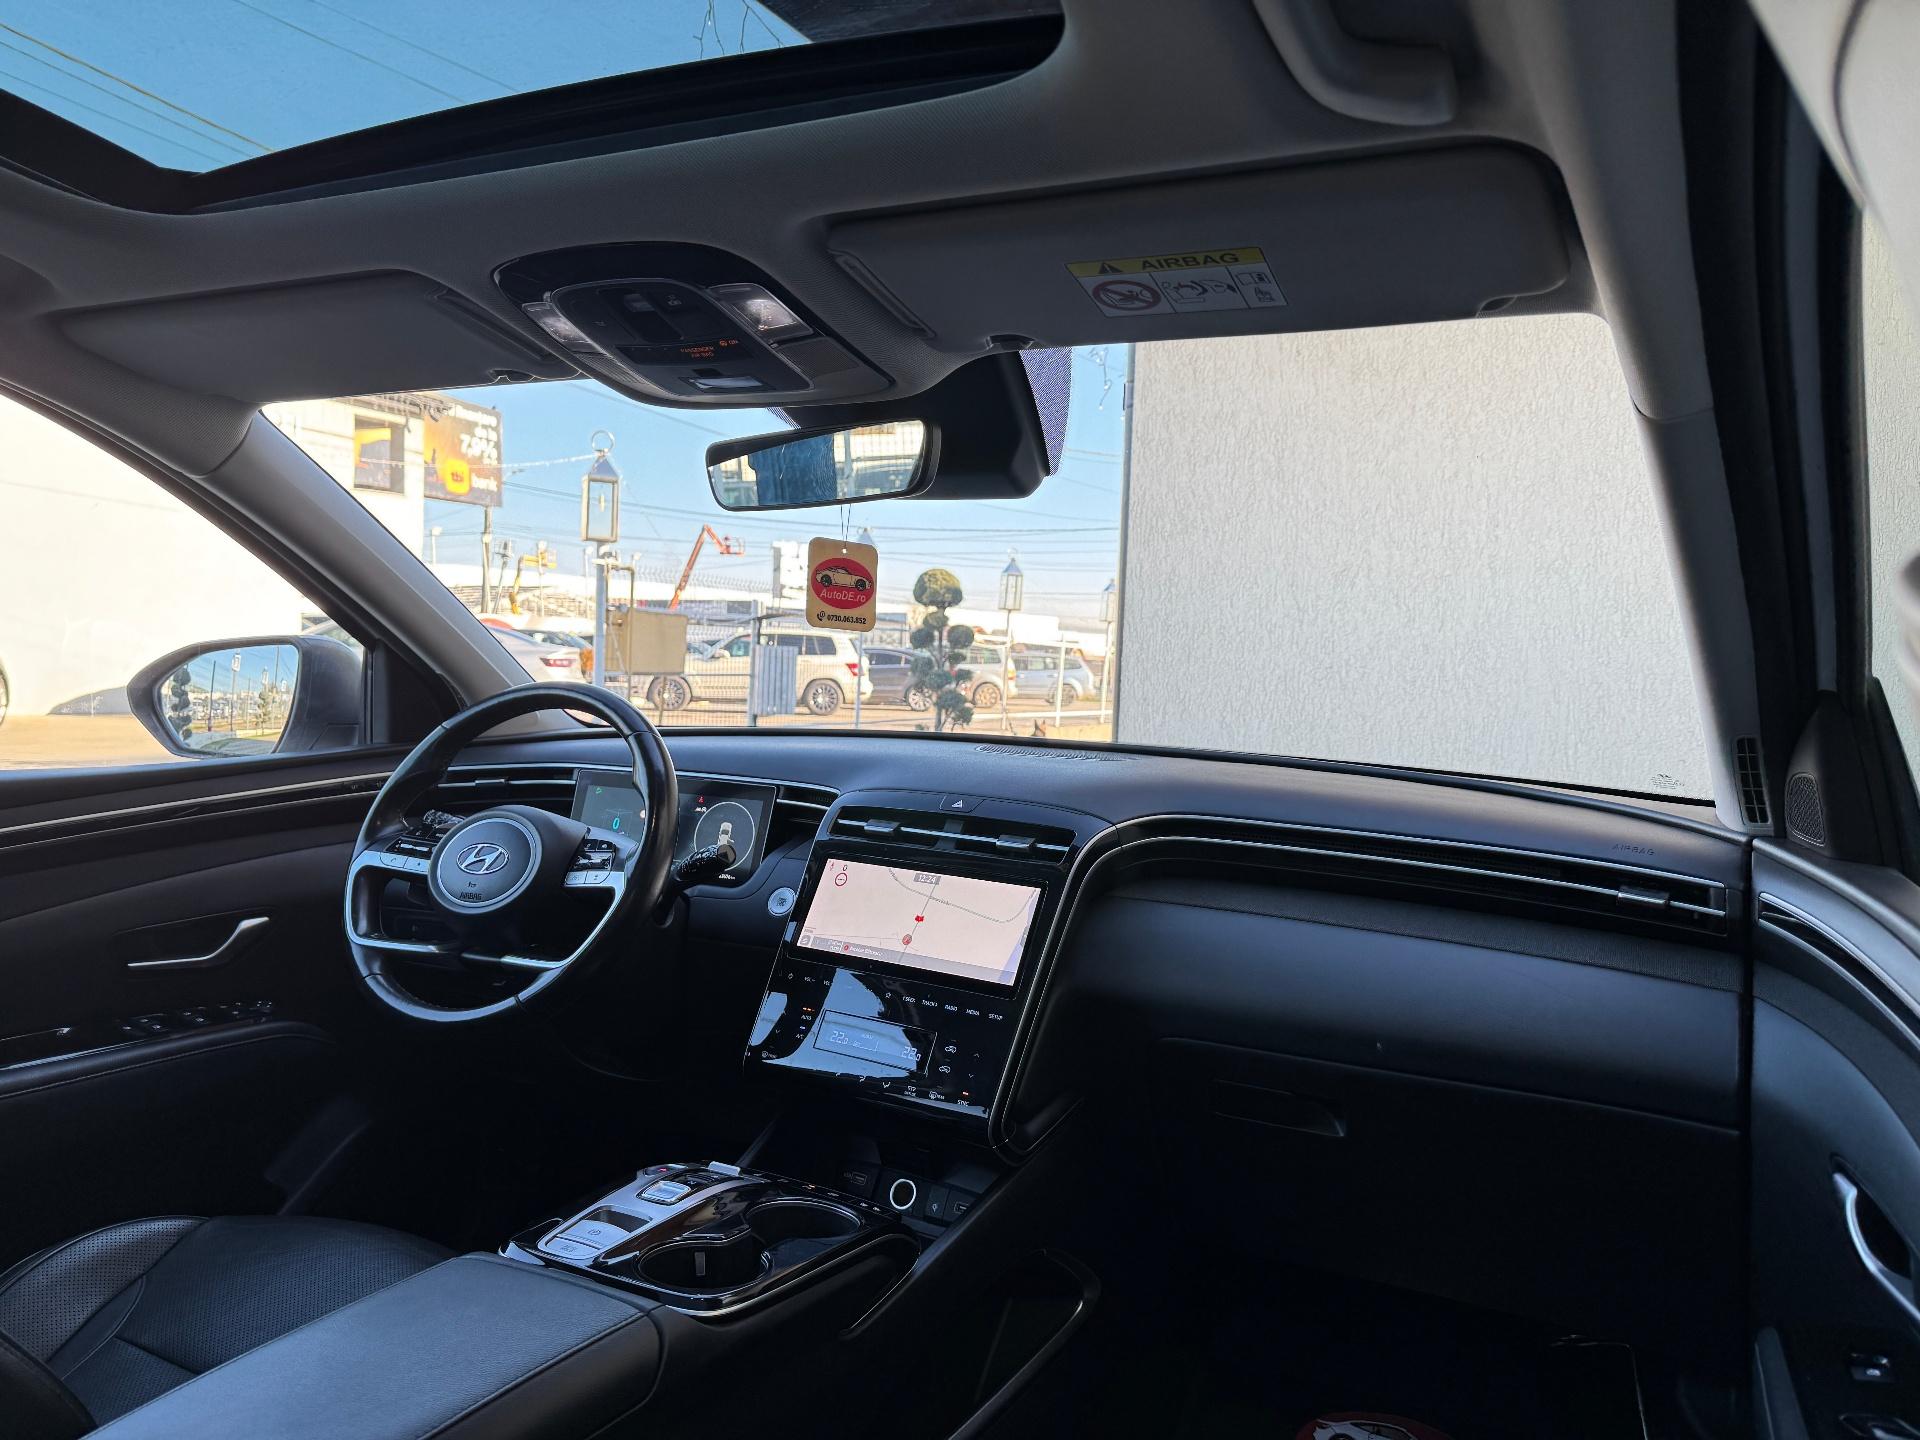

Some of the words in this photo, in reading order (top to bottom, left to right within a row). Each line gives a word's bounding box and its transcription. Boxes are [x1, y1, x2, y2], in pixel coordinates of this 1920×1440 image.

[1142, 253, 1239, 271] AIRBAG
[820, 588, 866, 603] AutoDE.ro
[612, 817, 620, 830] 0
[1612, 843, 1656, 856] AIRBAG
